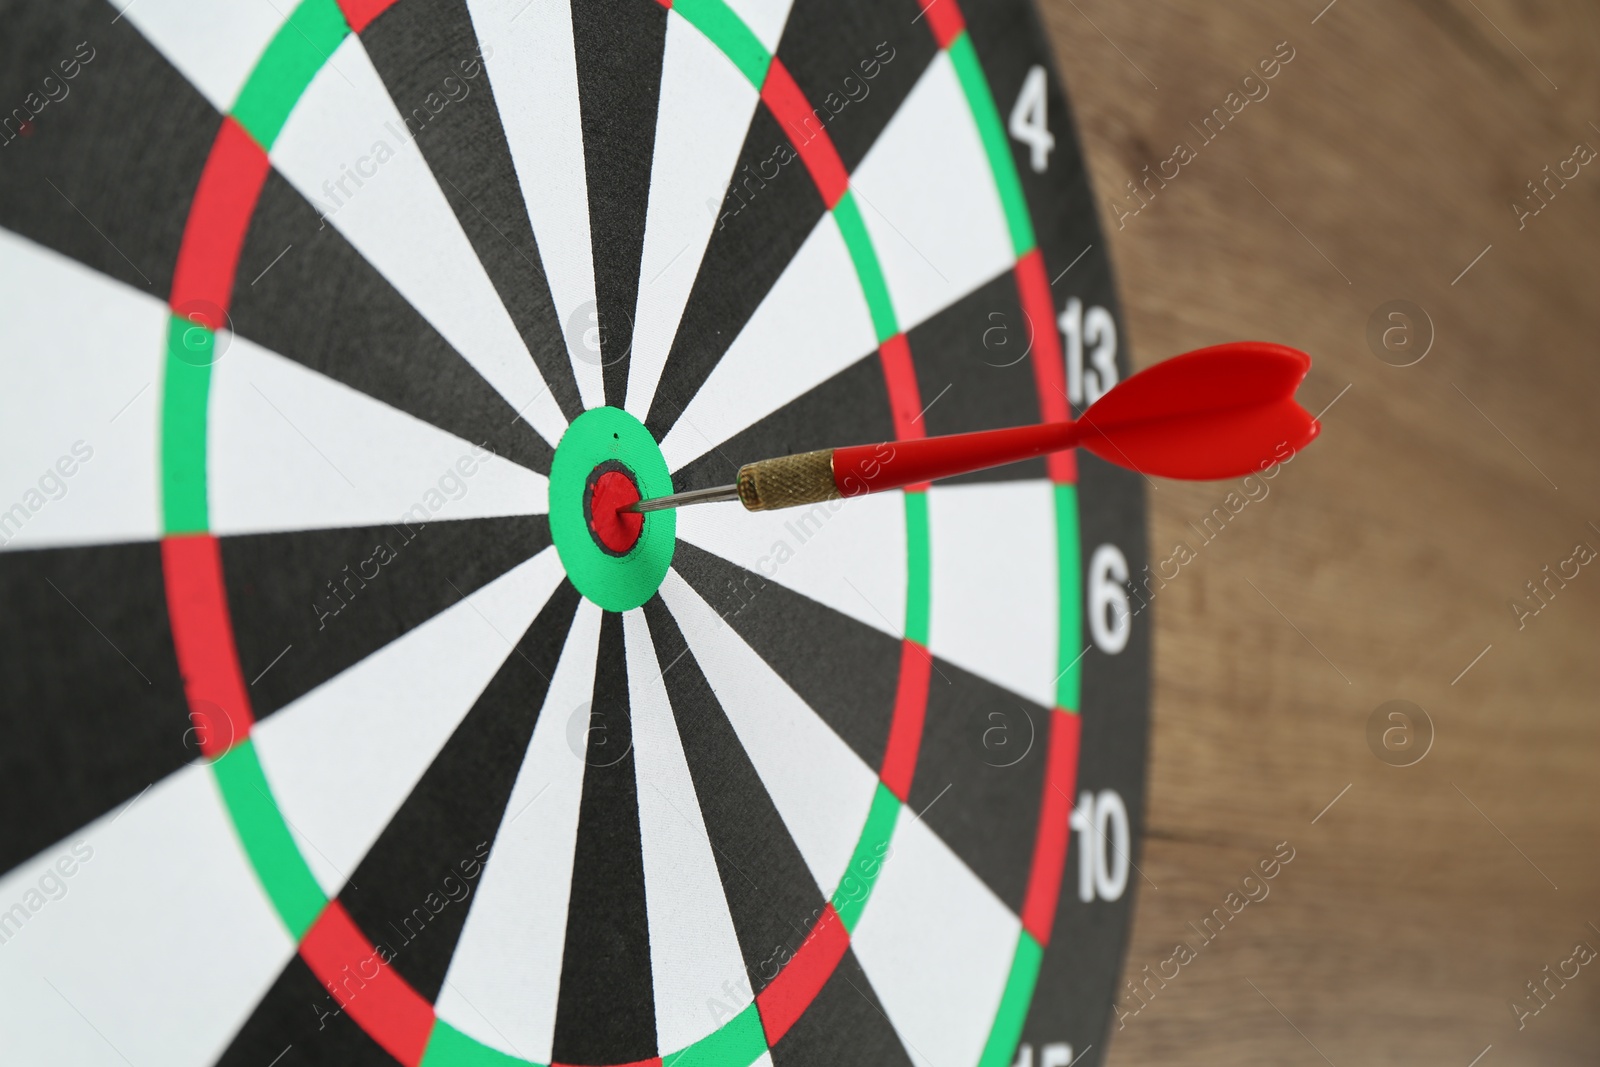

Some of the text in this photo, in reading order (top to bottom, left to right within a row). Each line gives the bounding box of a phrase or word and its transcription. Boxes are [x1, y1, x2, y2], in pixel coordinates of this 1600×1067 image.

[1008, 65, 1055, 173] 4
[1057, 296, 1119, 407] 13
[1087, 543, 1131, 655] 6
[1069, 788, 1131, 902] 10
